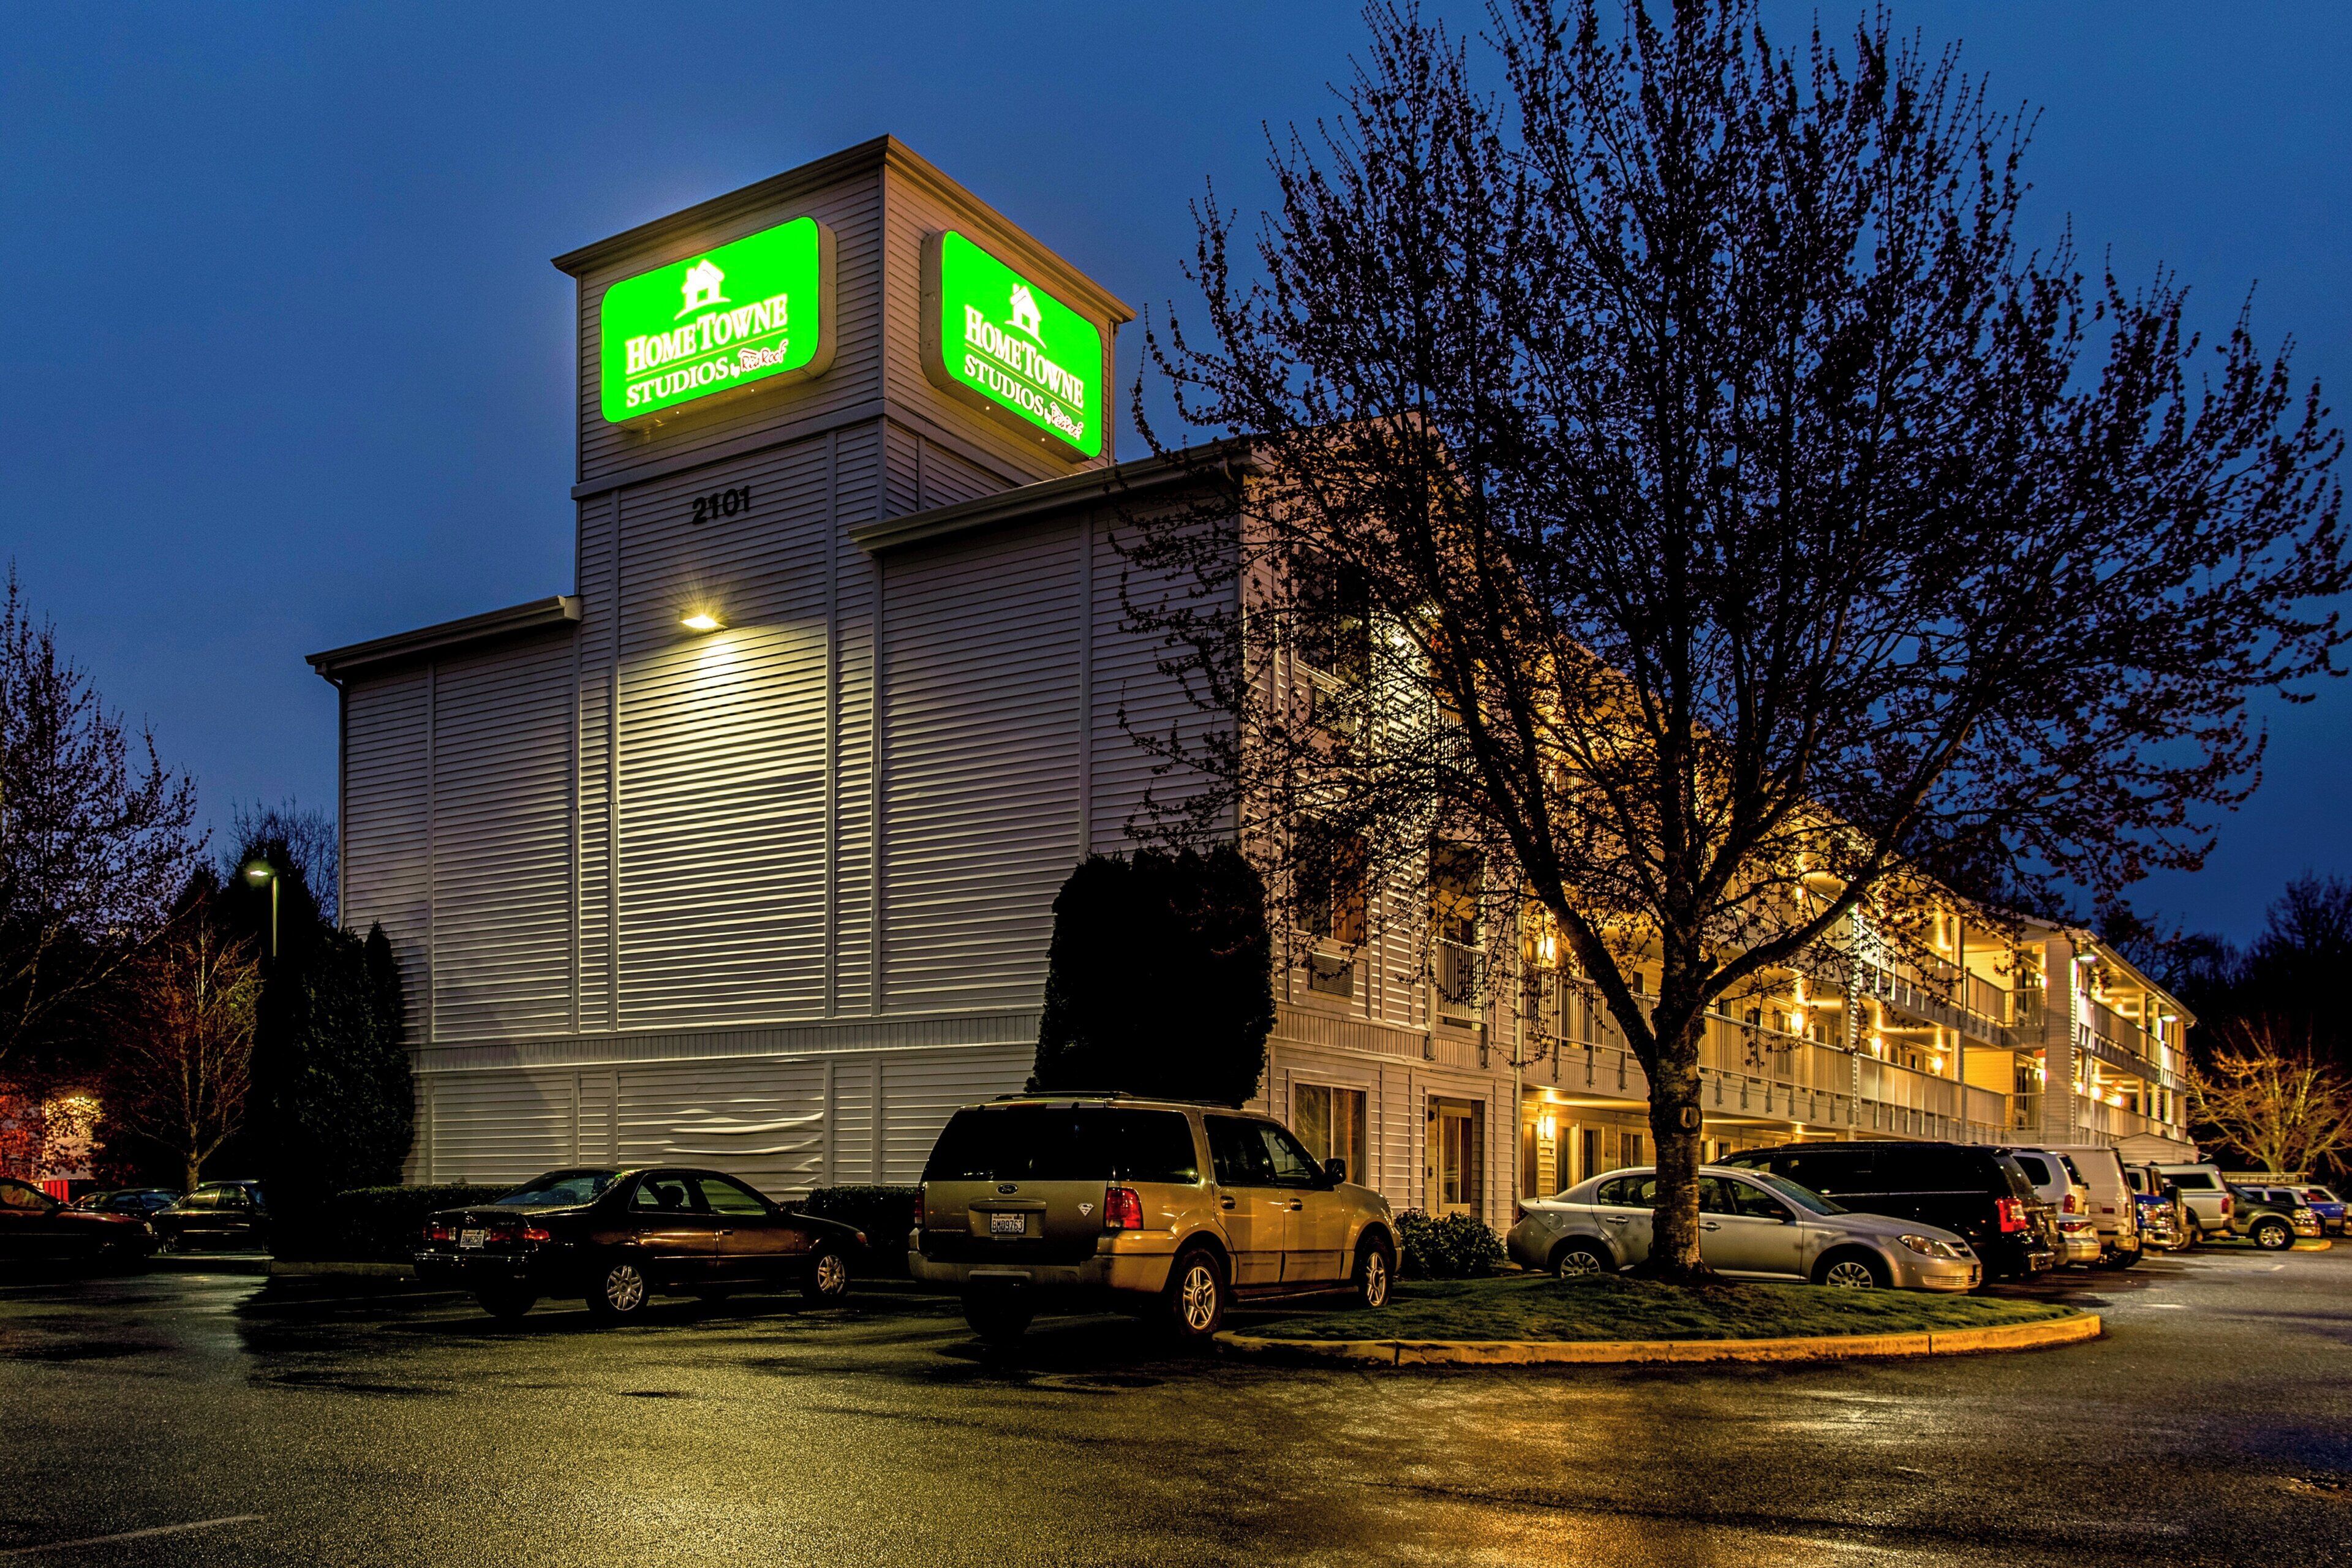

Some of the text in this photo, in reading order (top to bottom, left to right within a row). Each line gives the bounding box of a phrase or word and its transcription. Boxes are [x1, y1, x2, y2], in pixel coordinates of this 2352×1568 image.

[626, 356, 728, 408] STUDIOS
[965, 353, 1044, 417] STUDIOS
[692, 485, 750, 524] 2101
